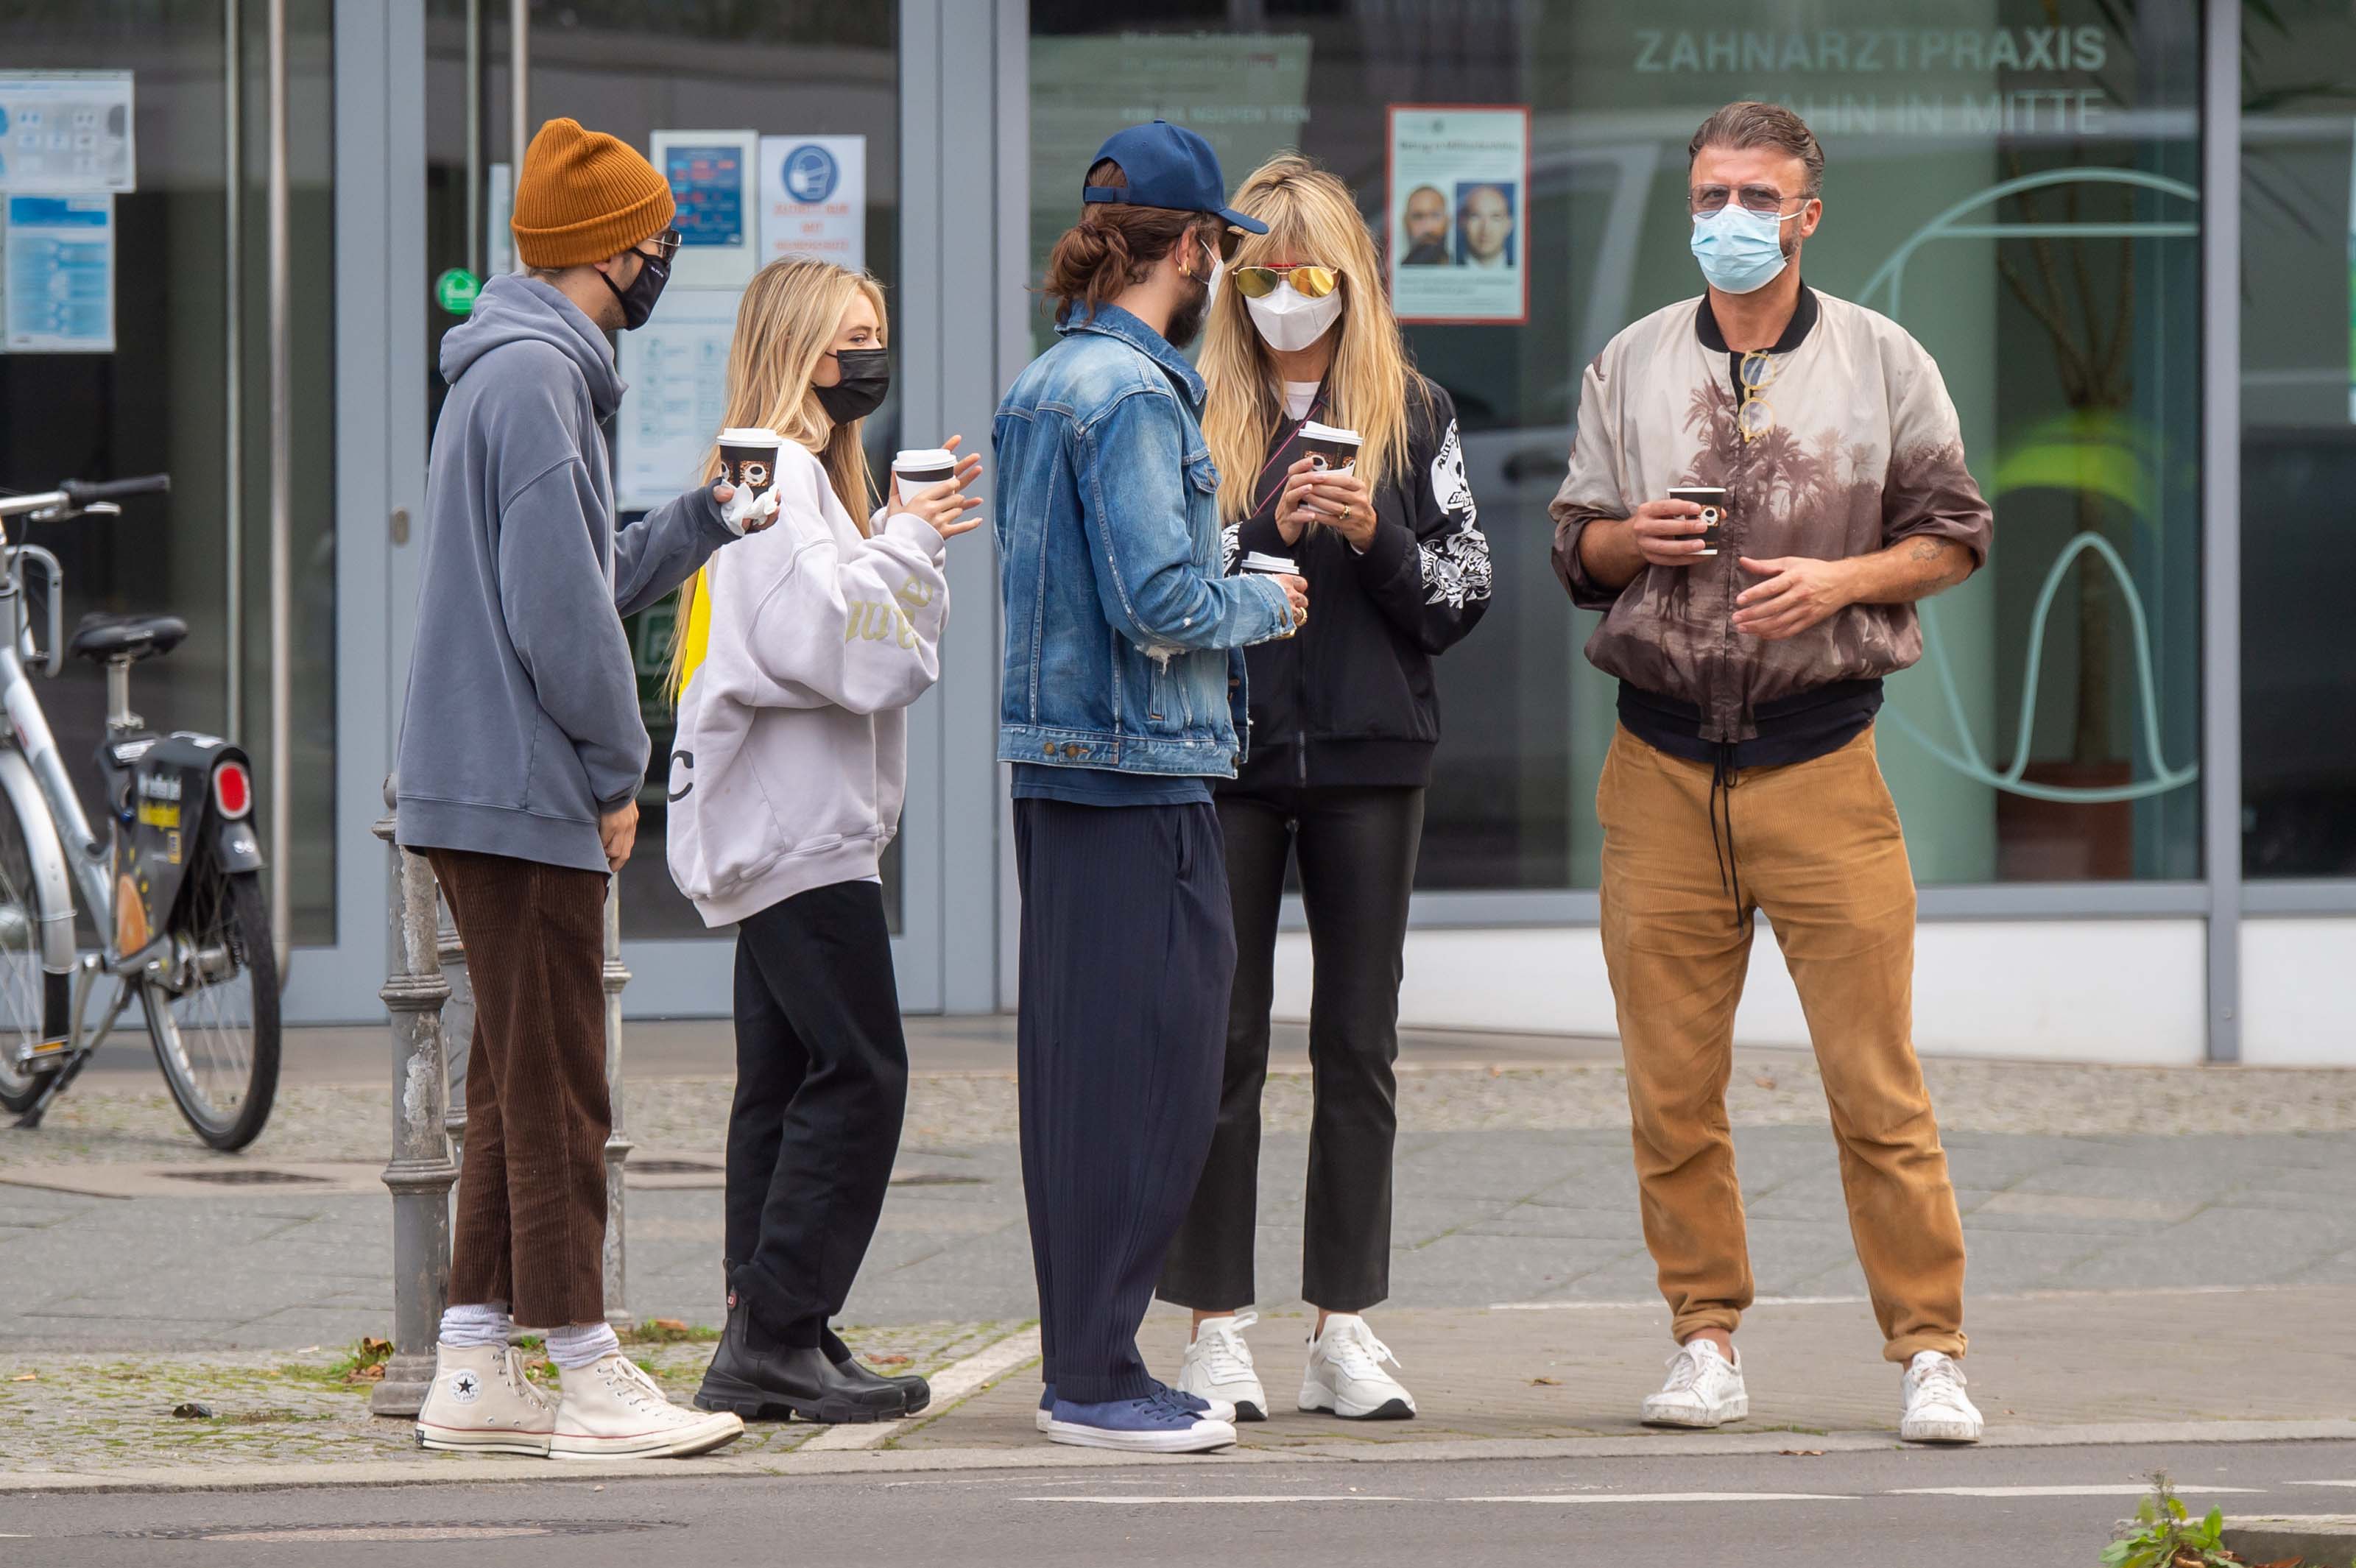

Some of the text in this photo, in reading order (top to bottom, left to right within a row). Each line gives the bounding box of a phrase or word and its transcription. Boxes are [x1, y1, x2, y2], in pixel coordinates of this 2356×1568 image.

[1633, 26, 2107, 71] ZAHNARZTPRAXIS
[1896, 90, 1945, 135] IN
[1961, 88, 2107, 135] MITTE
